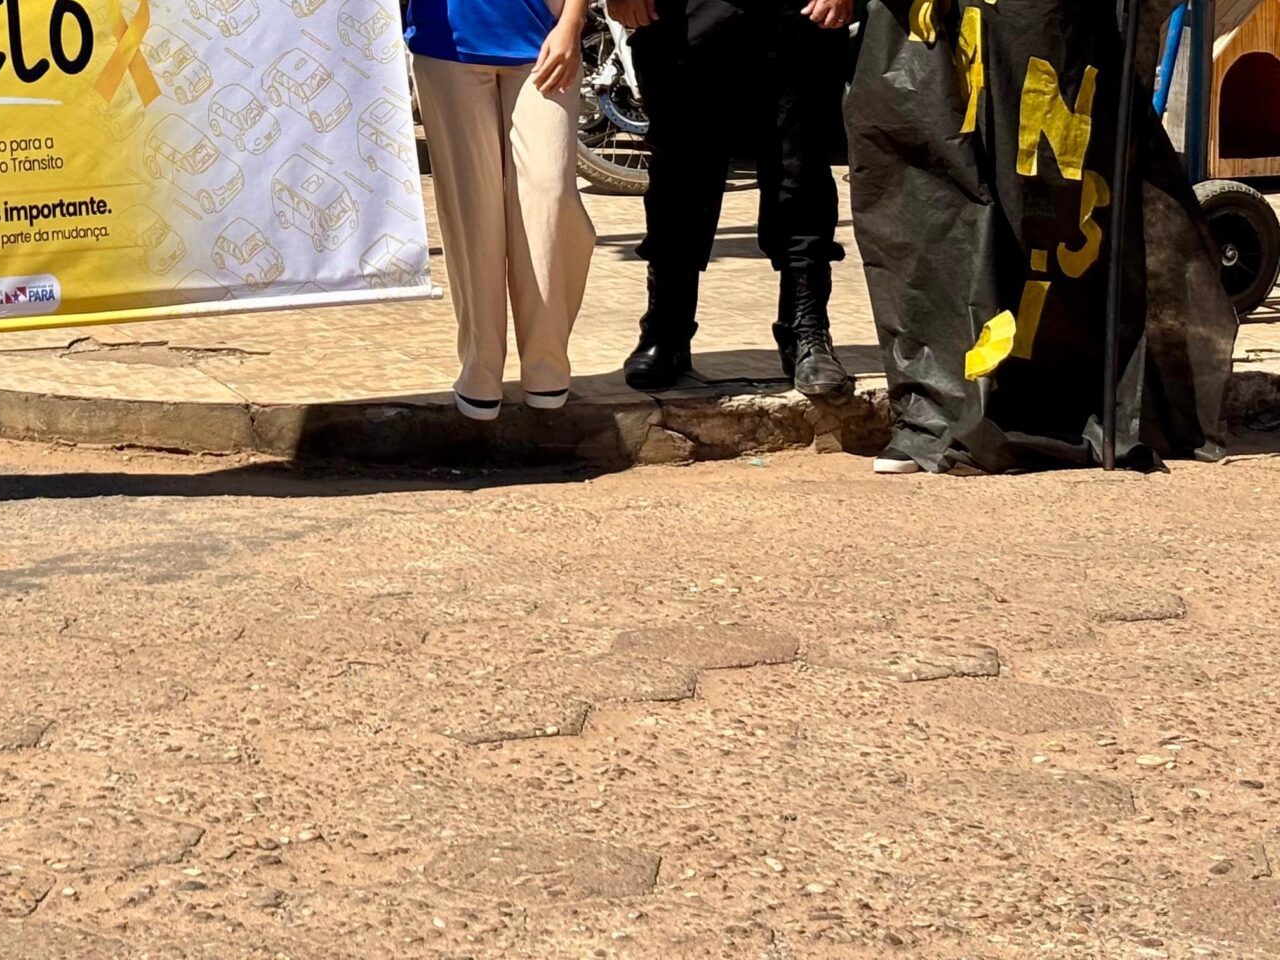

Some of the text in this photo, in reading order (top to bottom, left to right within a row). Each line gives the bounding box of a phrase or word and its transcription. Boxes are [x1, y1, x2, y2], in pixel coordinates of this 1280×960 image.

[10, 138, 42, 157] para
[44, 137, 54, 149] a
[10, 154, 64, 172] Trânsito
[3, 196, 112, 227] importante.
[1, 231, 32, 249] parte
[33, 229, 50, 242] da
